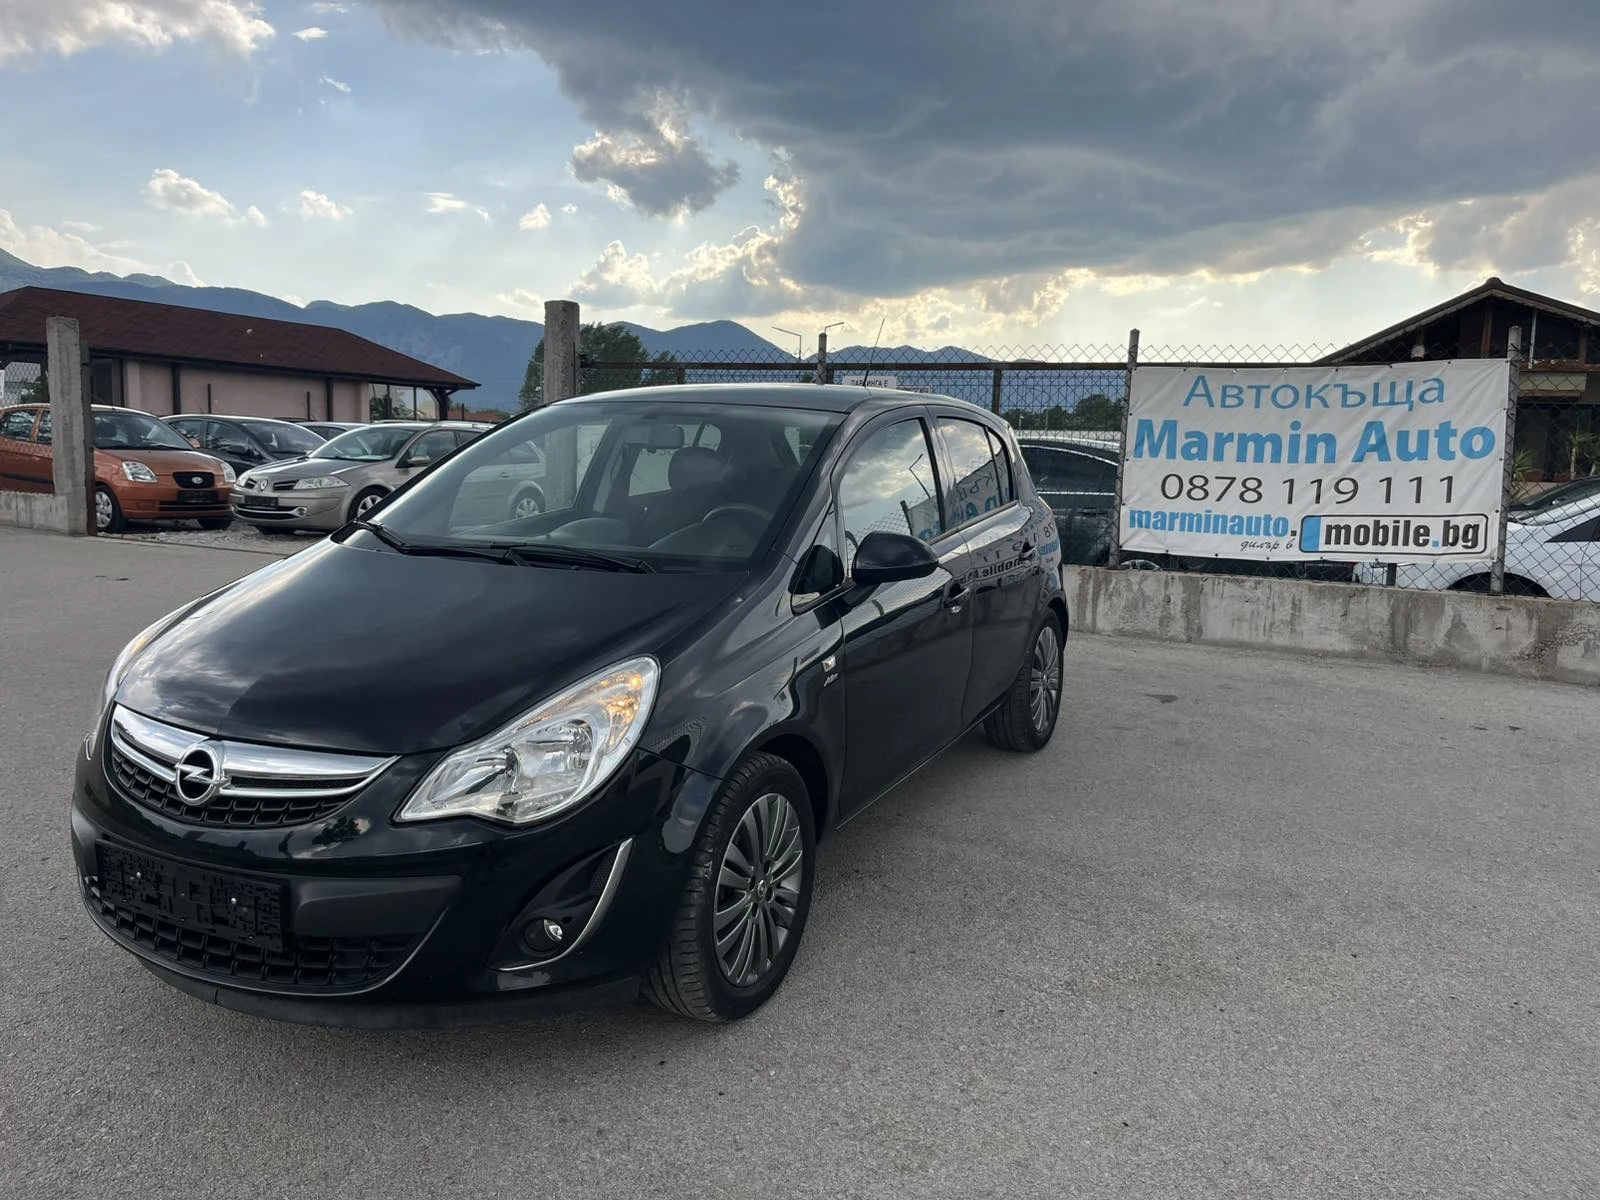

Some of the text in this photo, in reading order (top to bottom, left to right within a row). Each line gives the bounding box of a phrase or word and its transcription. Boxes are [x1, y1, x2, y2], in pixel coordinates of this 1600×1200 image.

[1183, 375, 1445, 411] Автокъща
[1133, 419, 1496, 464] Marmin Auto
[1161, 473, 1454, 504] 0878 119 111
[1324, 519, 1480, 549] mobile.bg
